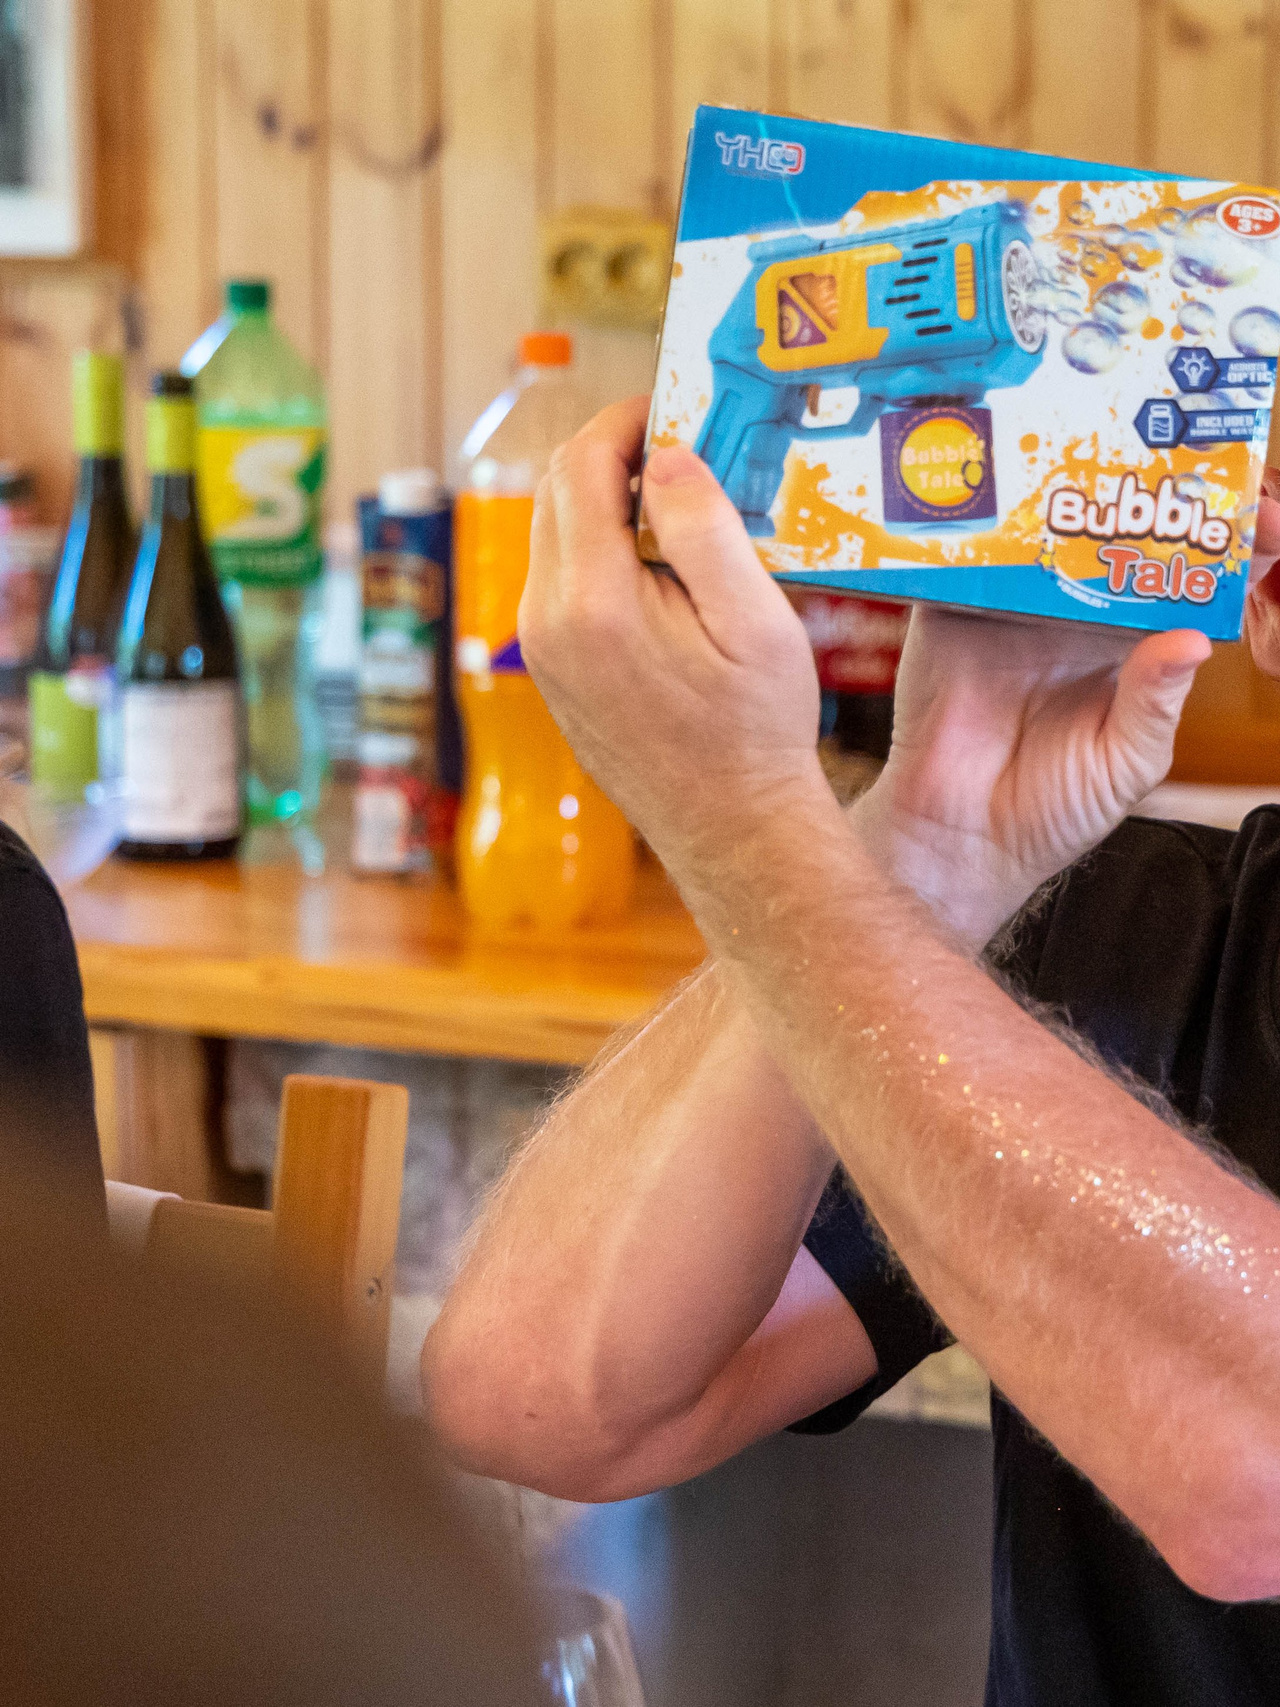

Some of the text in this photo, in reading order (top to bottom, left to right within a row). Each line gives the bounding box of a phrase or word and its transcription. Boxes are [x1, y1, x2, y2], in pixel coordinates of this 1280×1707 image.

[1229, 203, 1275, 222] AGES
[1237, 218, 1262, 233] 3+
[1048, 471, 1232, 555] Bubble
[1098, 544, 1217, 605] Tale
